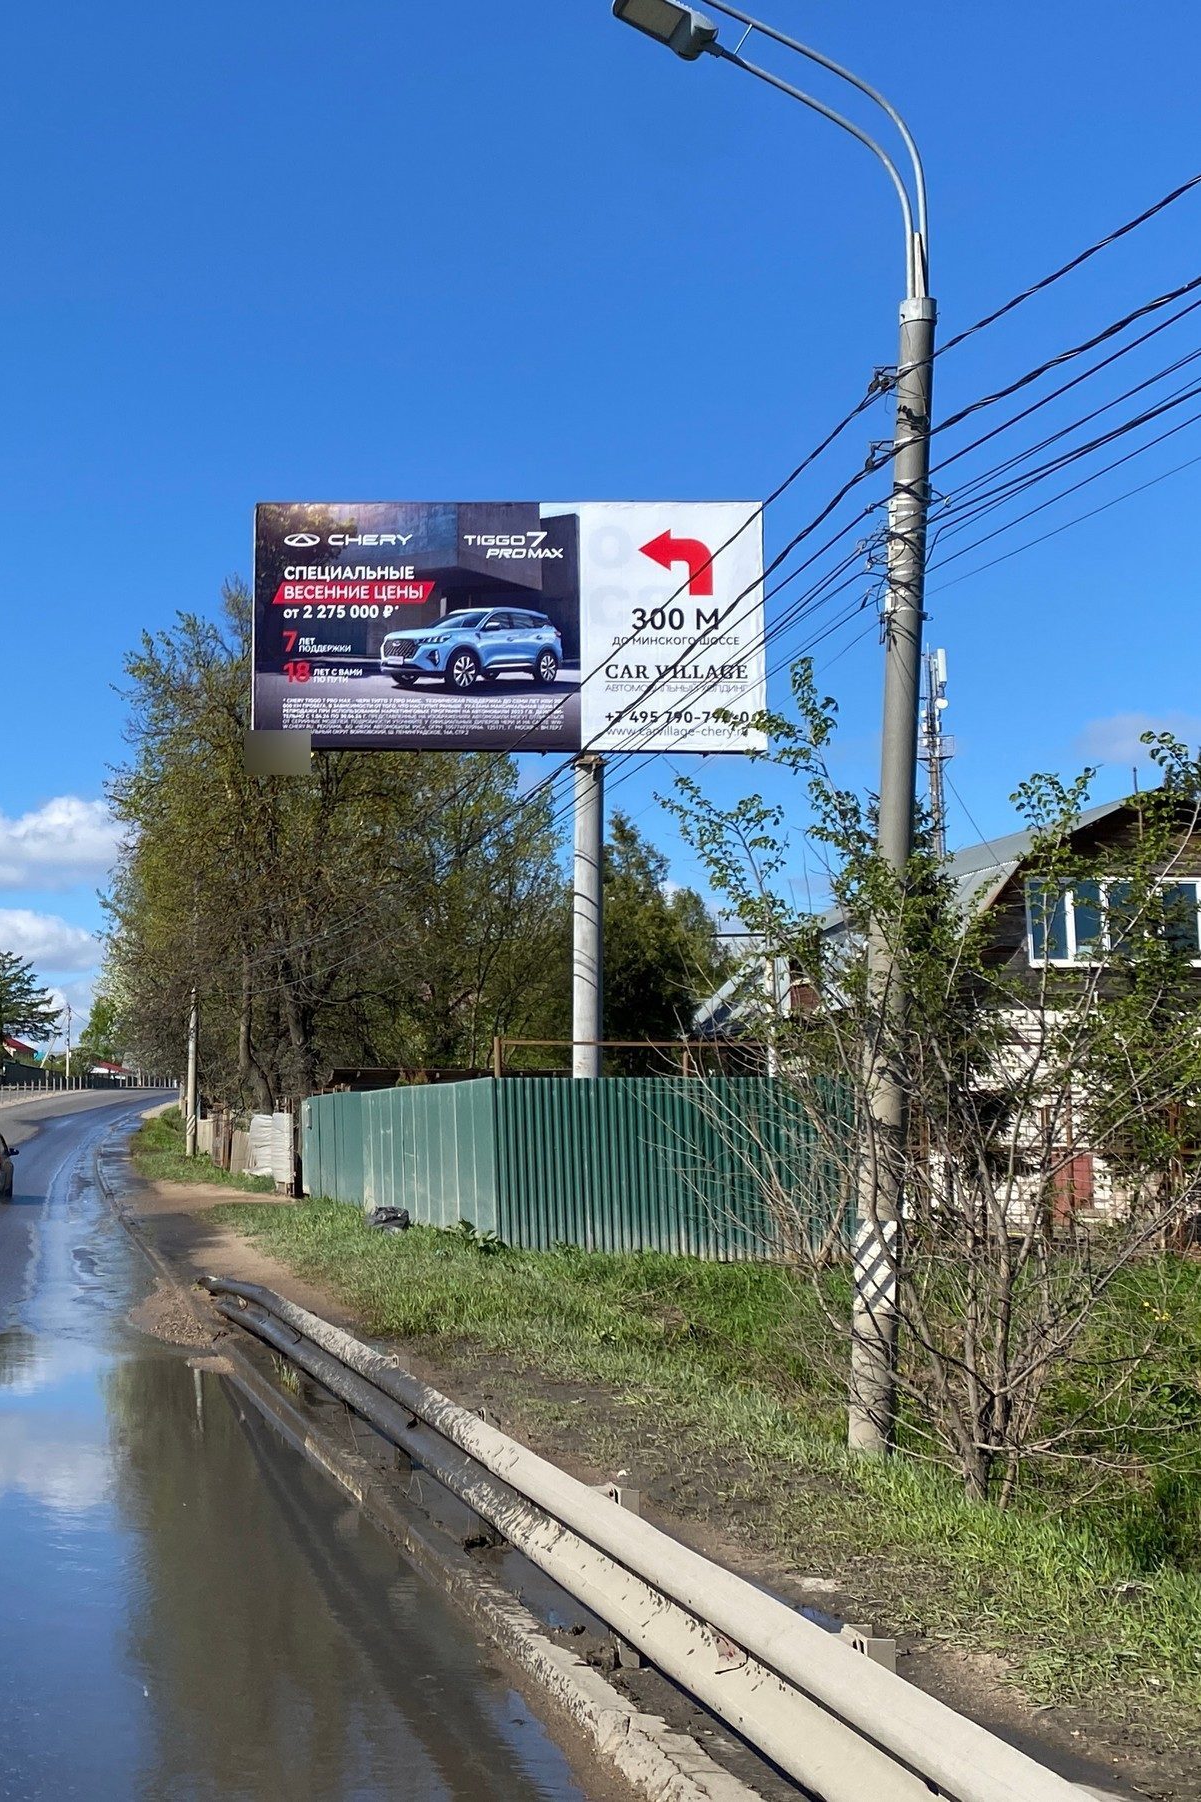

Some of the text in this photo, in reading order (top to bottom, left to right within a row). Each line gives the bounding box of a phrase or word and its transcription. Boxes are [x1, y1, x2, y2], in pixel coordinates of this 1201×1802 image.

[327, 533, 414, 546] CHERY
[463, 534, 526, 546] TIGGO
[485, 548, 564, 559] PRO MAX
[283, 565, 415, 582] СПЕЦИАЛЬНЫЕ
[283, 585, 424, 605] ВЕСЕННИЕ ЦЕНЫ
[283, 607, 300, 619] от
[302, 605, 313, 619] 2
[316, 605, 346, 619] 275
[349, 605, 380, 619] 000
[631, 607, 720, 631] 300 М
[282, 630, 298, 653] 7
[298, 637, 316, 646] ЛЕТ
[612, 636, 740, 647] ДО МИНСКОГО ШОССЕ
[298, 645, 352, 654] ПОДДЕРЖКИ
[283, 660, 312, 684] 18
[313, 668, 330, 676] ЛЕТ
[604, 664, 748, 679] CAR VILLAGE
[605, 682, 697, 693] АВТОМОИЛЬНЫЙ
[629, 710, 659, 723] 495
